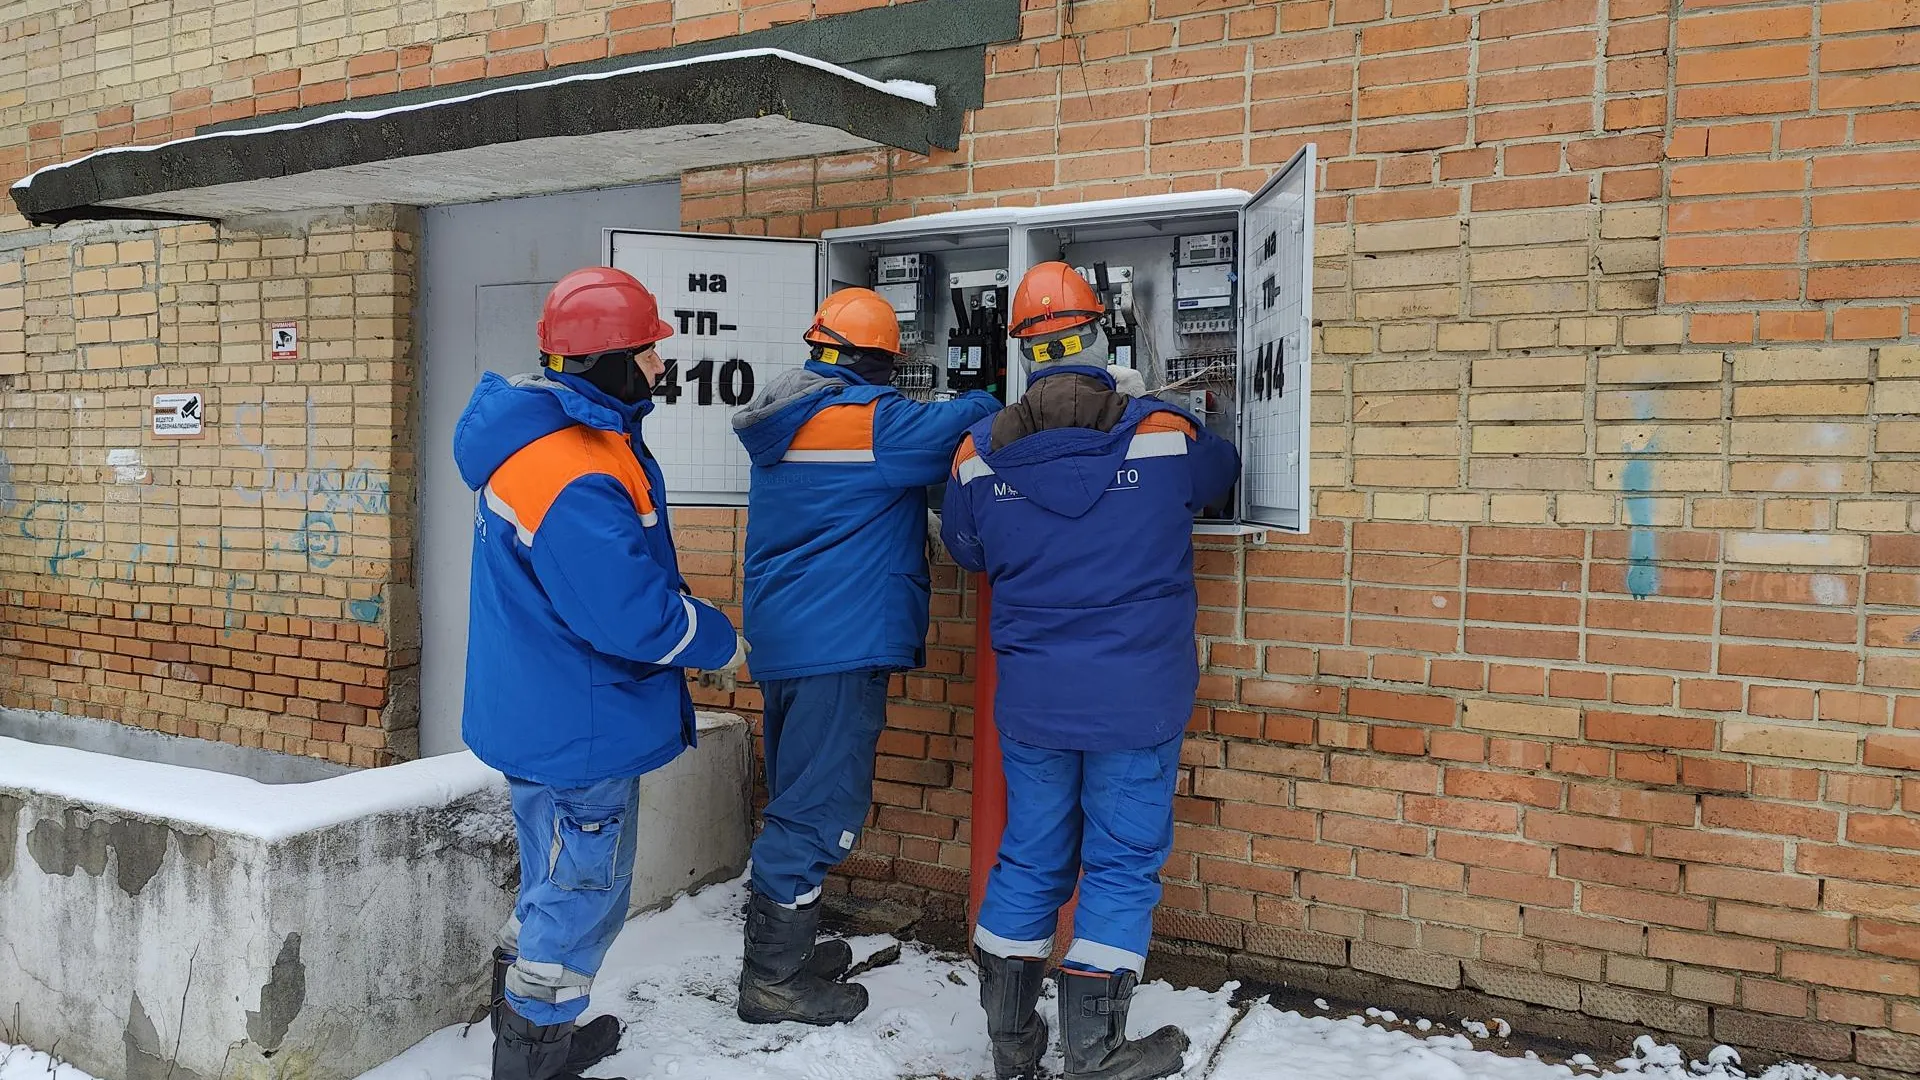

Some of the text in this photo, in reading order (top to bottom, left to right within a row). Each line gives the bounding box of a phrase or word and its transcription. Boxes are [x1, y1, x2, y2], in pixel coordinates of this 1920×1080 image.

[1264, 230, 1276, 260] на
[688, 273, 727, 292] на
[674, 310, 737, 335] ТП-
[651, 358, 754, 405] 410
[1253, 337, 1284, 401] 414
